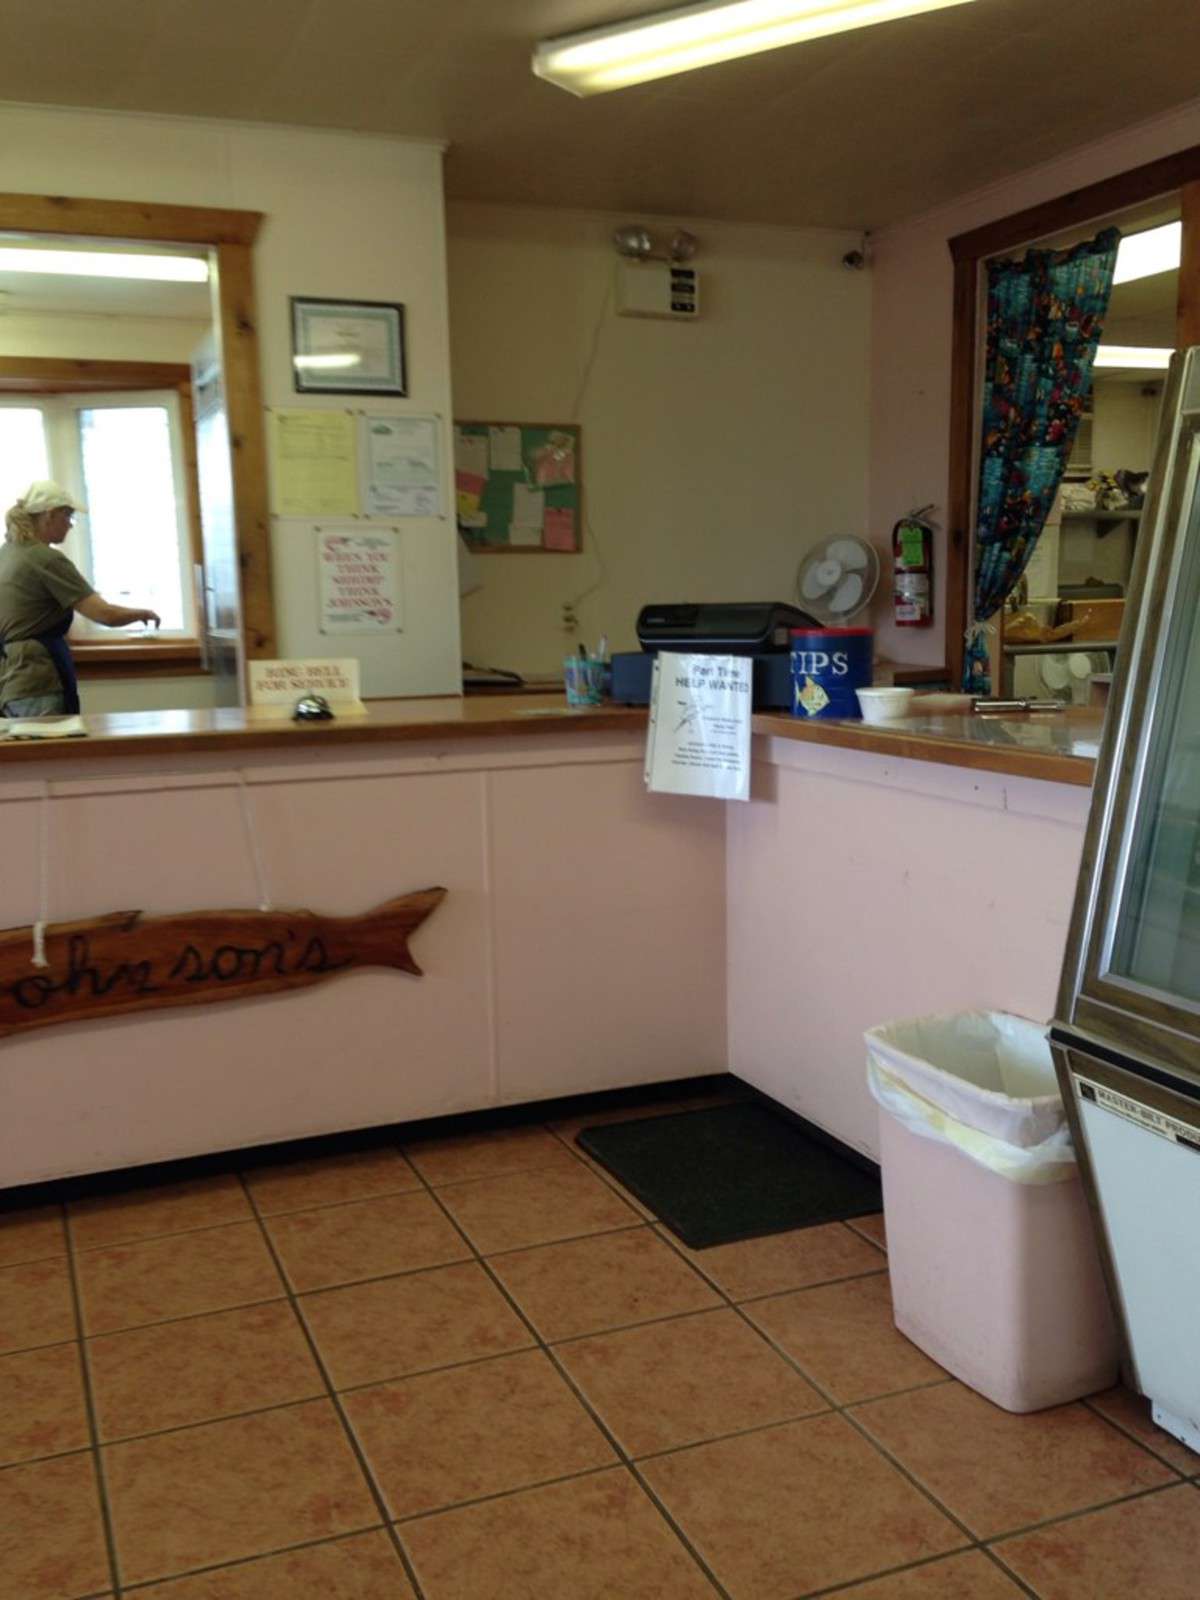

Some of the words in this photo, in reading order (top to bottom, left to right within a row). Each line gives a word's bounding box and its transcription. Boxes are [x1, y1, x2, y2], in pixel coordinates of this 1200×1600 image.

[675, 676, 705, 689] HELP
[708, 680, 749, 693] WANTED
[4, 932, 356, 1009] ohnson's
